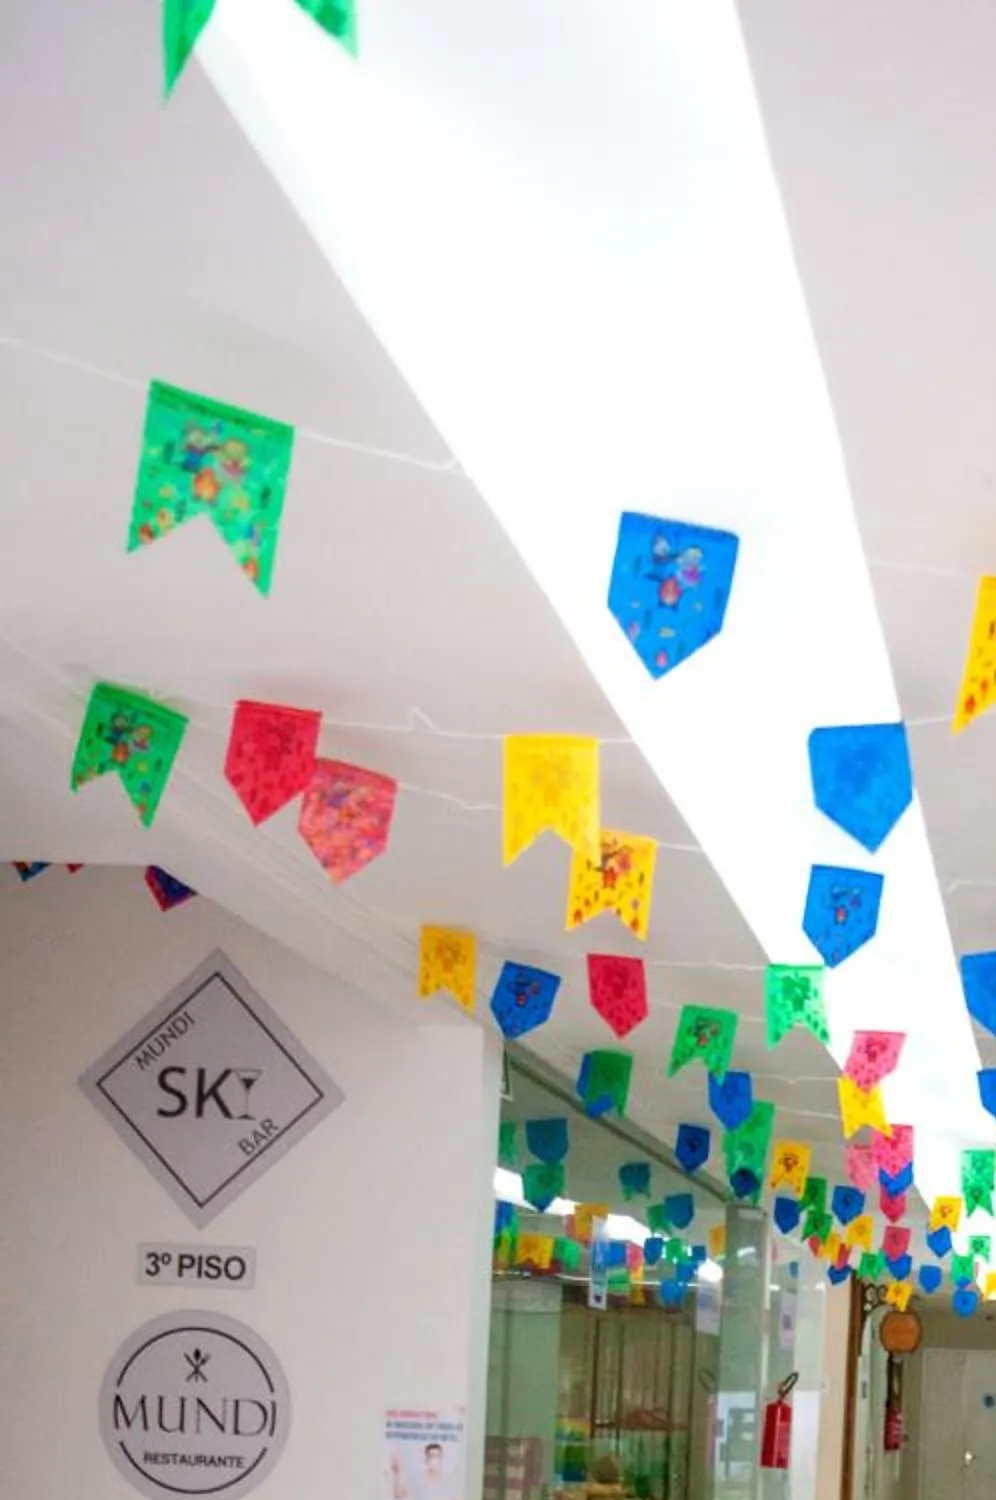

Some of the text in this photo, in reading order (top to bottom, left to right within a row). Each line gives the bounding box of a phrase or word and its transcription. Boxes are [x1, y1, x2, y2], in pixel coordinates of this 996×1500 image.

[135, 1010, 195, 1071] MUNDI
[237, 1117, 279, 1156] BAR
[177, 1253, 247, 1281] PISO
[113, 1393, 276, 1437] MUNDI
[143, 1451, 246, 1469] RESTAURANTE
